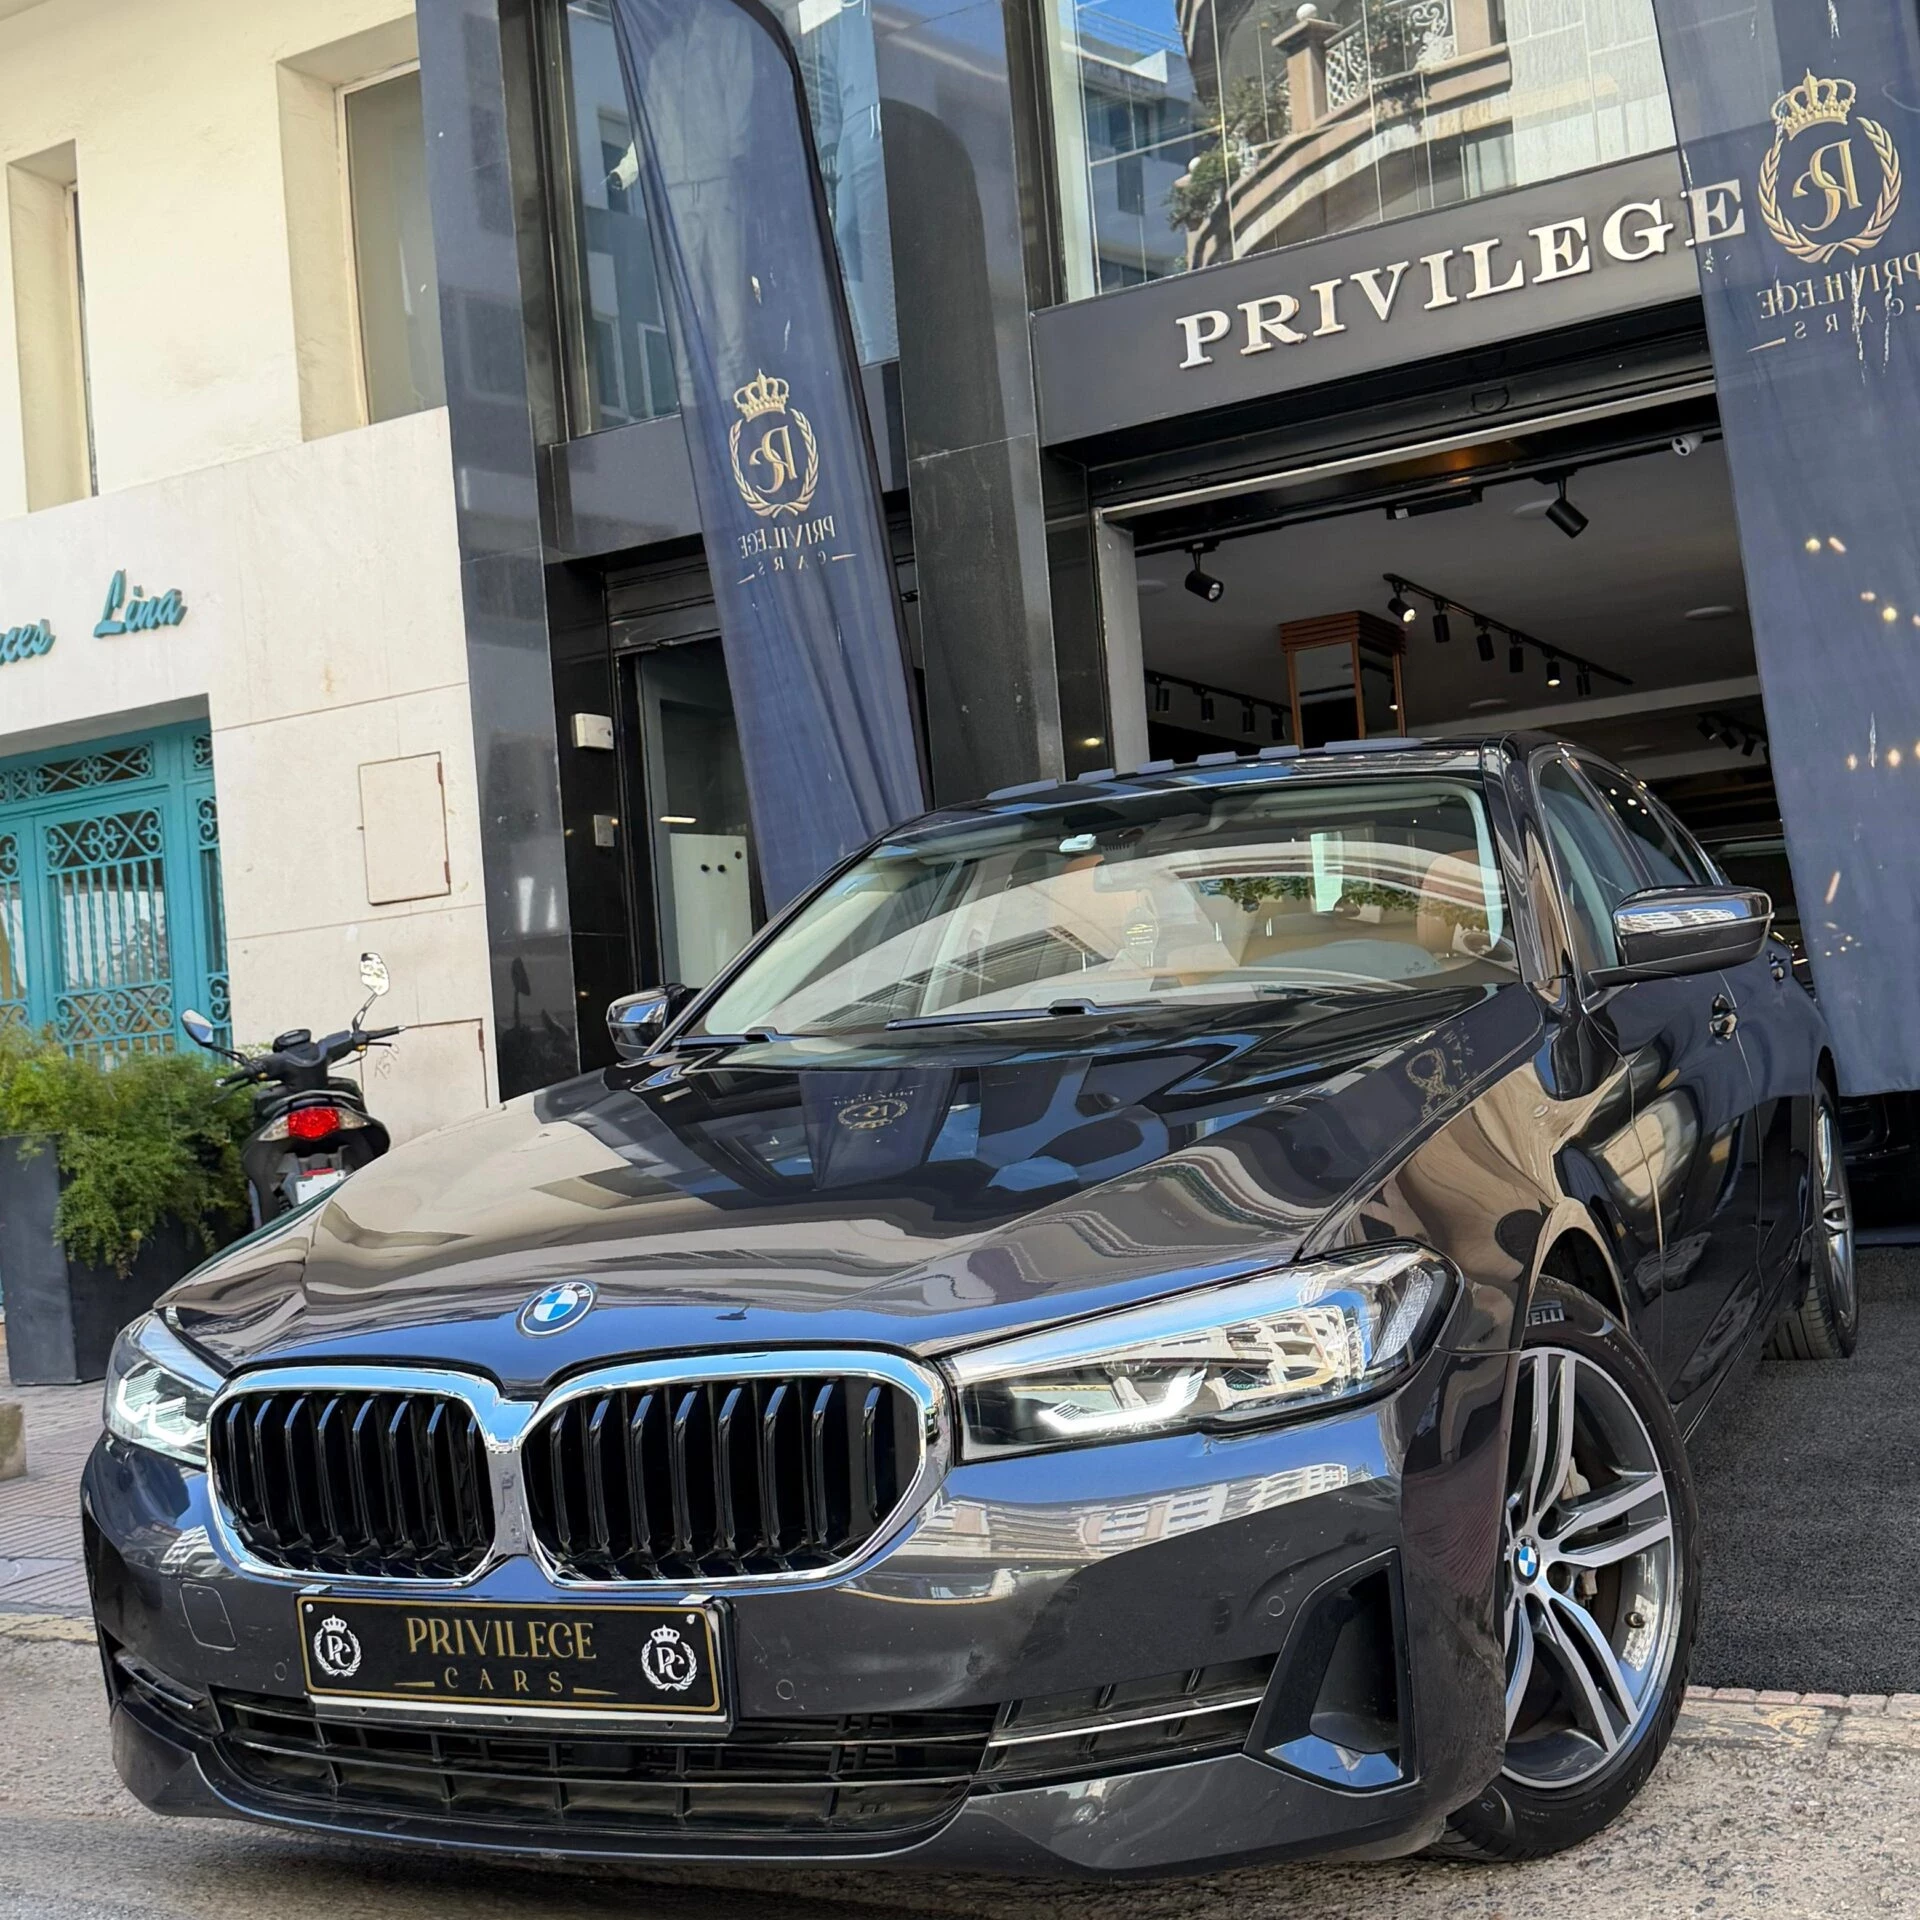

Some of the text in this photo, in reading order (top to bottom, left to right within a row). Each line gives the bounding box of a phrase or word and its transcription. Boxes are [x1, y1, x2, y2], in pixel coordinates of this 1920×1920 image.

[1175, 179, 1746, 369] PRIVILEGE
[93, 568, 188, 638] Lina
[407, 1617, 597, 1660] PRIVILEGE
[444, 1666, 563, 1693] CARS
